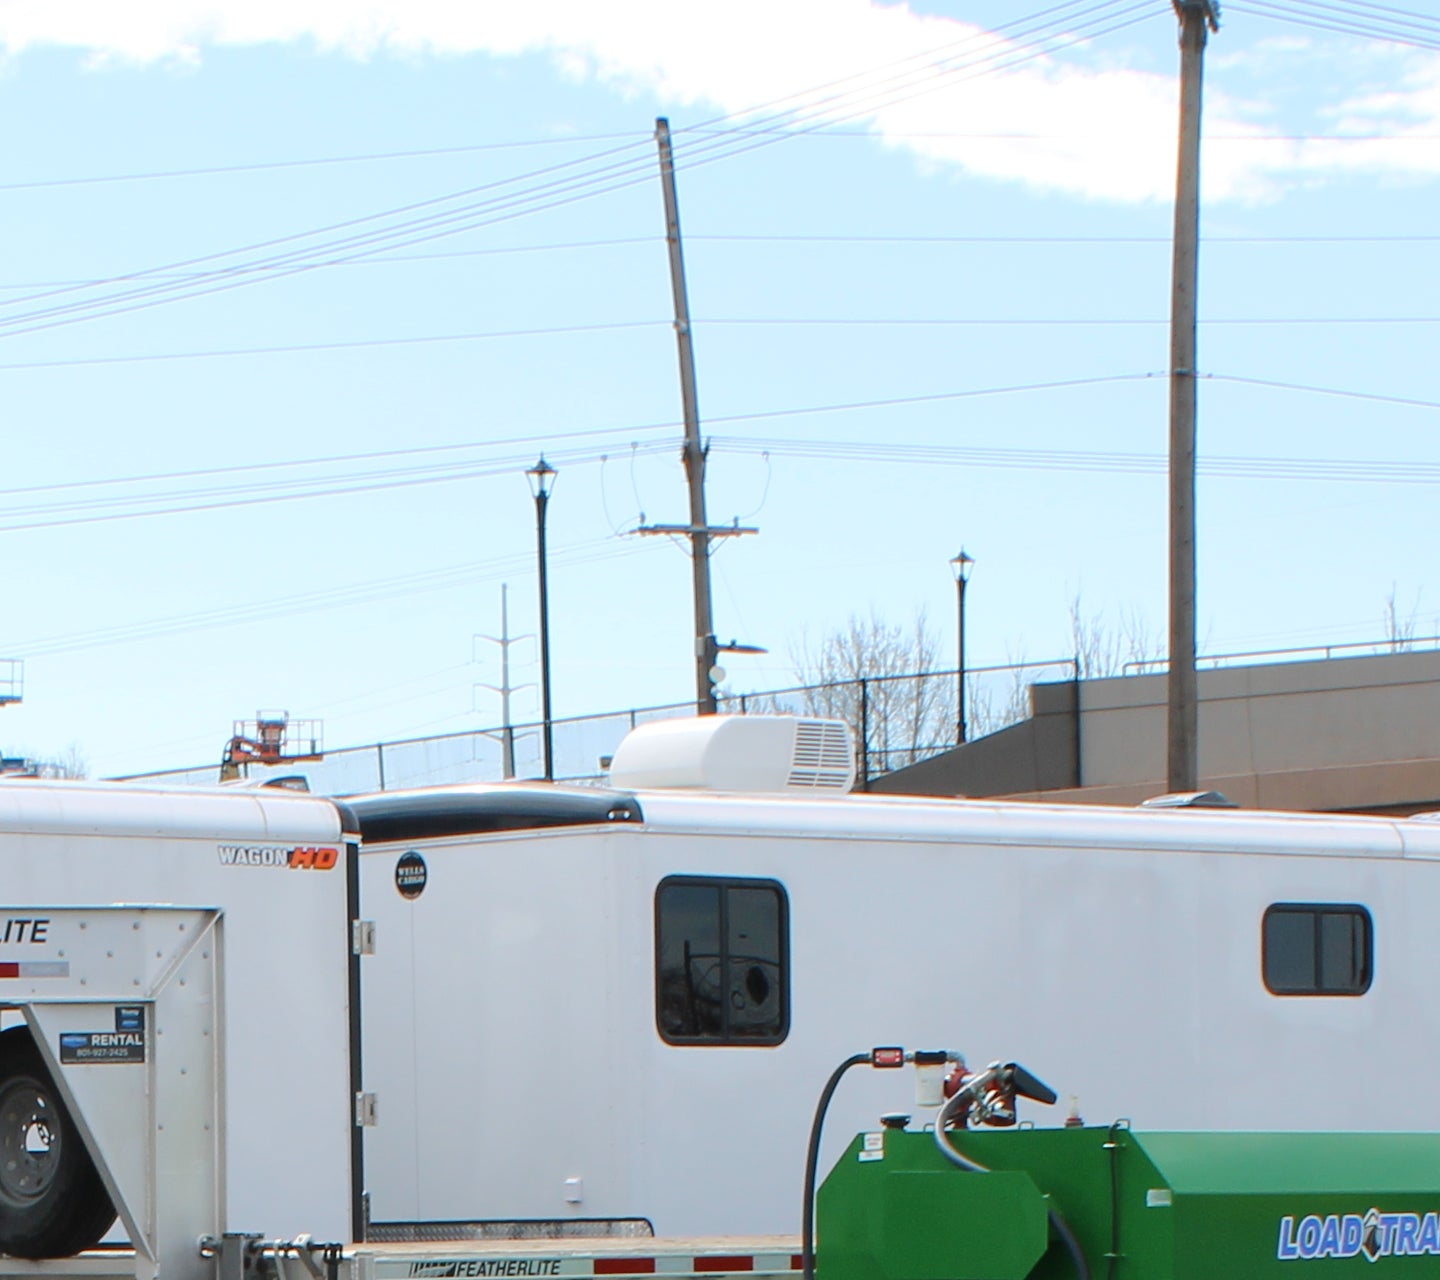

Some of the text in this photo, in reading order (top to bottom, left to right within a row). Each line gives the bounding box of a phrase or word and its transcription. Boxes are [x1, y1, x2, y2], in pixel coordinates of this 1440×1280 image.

[218, 847, 339, 870] WAGON HD
[91, 1034, 143, 1047] RENTAL
[1277, 1213, 1365, 1260] LOAD
[456, 1259, 562, 1277] FEATHERLITE
